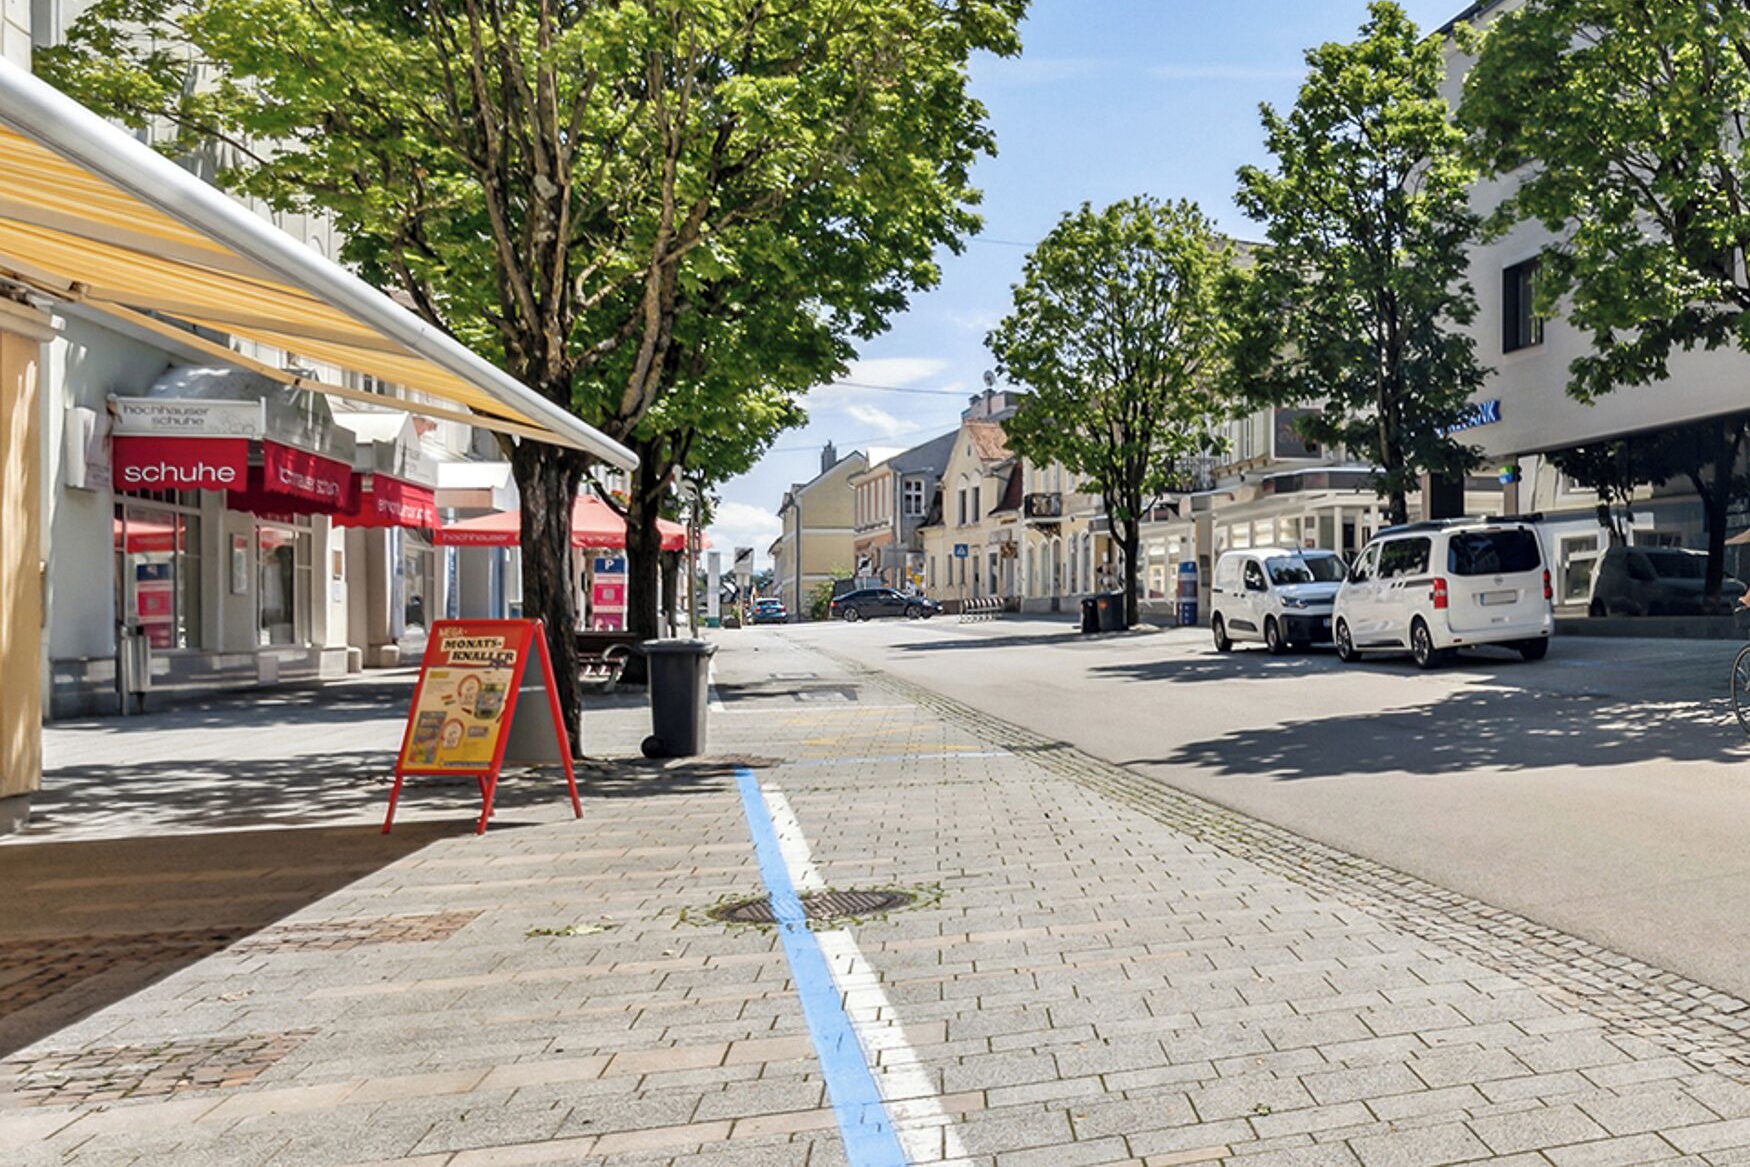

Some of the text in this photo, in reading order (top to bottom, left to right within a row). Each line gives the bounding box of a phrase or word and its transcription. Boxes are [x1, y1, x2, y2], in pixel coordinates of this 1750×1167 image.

[152, 416, 204, 426] schuhe
[124, 461, 236, 483] schuhe
[444, 638, 502, 649] MONATS-
[452, 650, 514, 662] KNALLER
